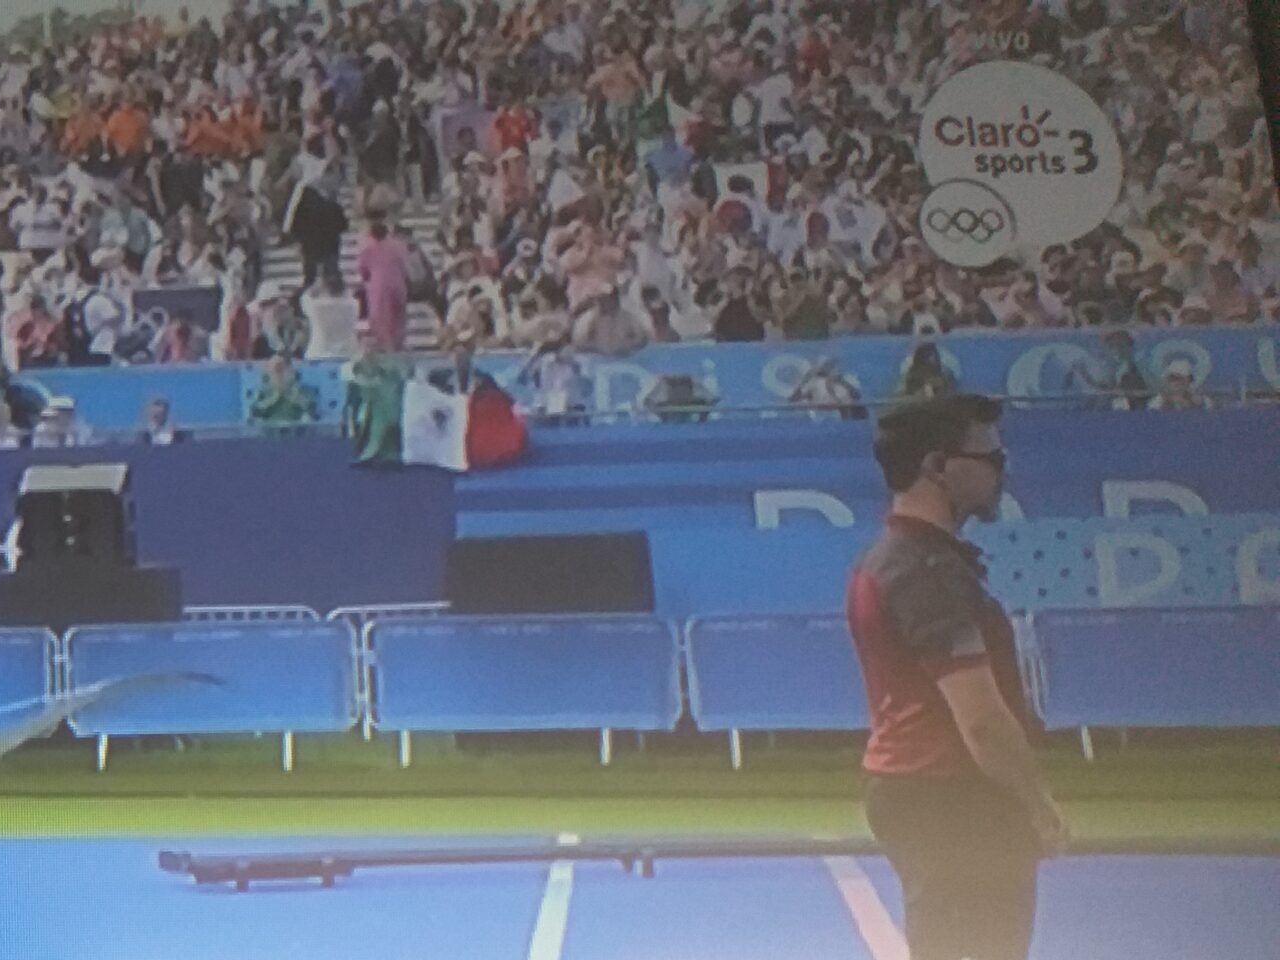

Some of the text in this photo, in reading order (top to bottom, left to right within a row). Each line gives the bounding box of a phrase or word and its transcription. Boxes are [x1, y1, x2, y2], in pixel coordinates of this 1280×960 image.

[934, 107, 1048, 147] Claro
[974, 129, 1098, 178] sports 3
